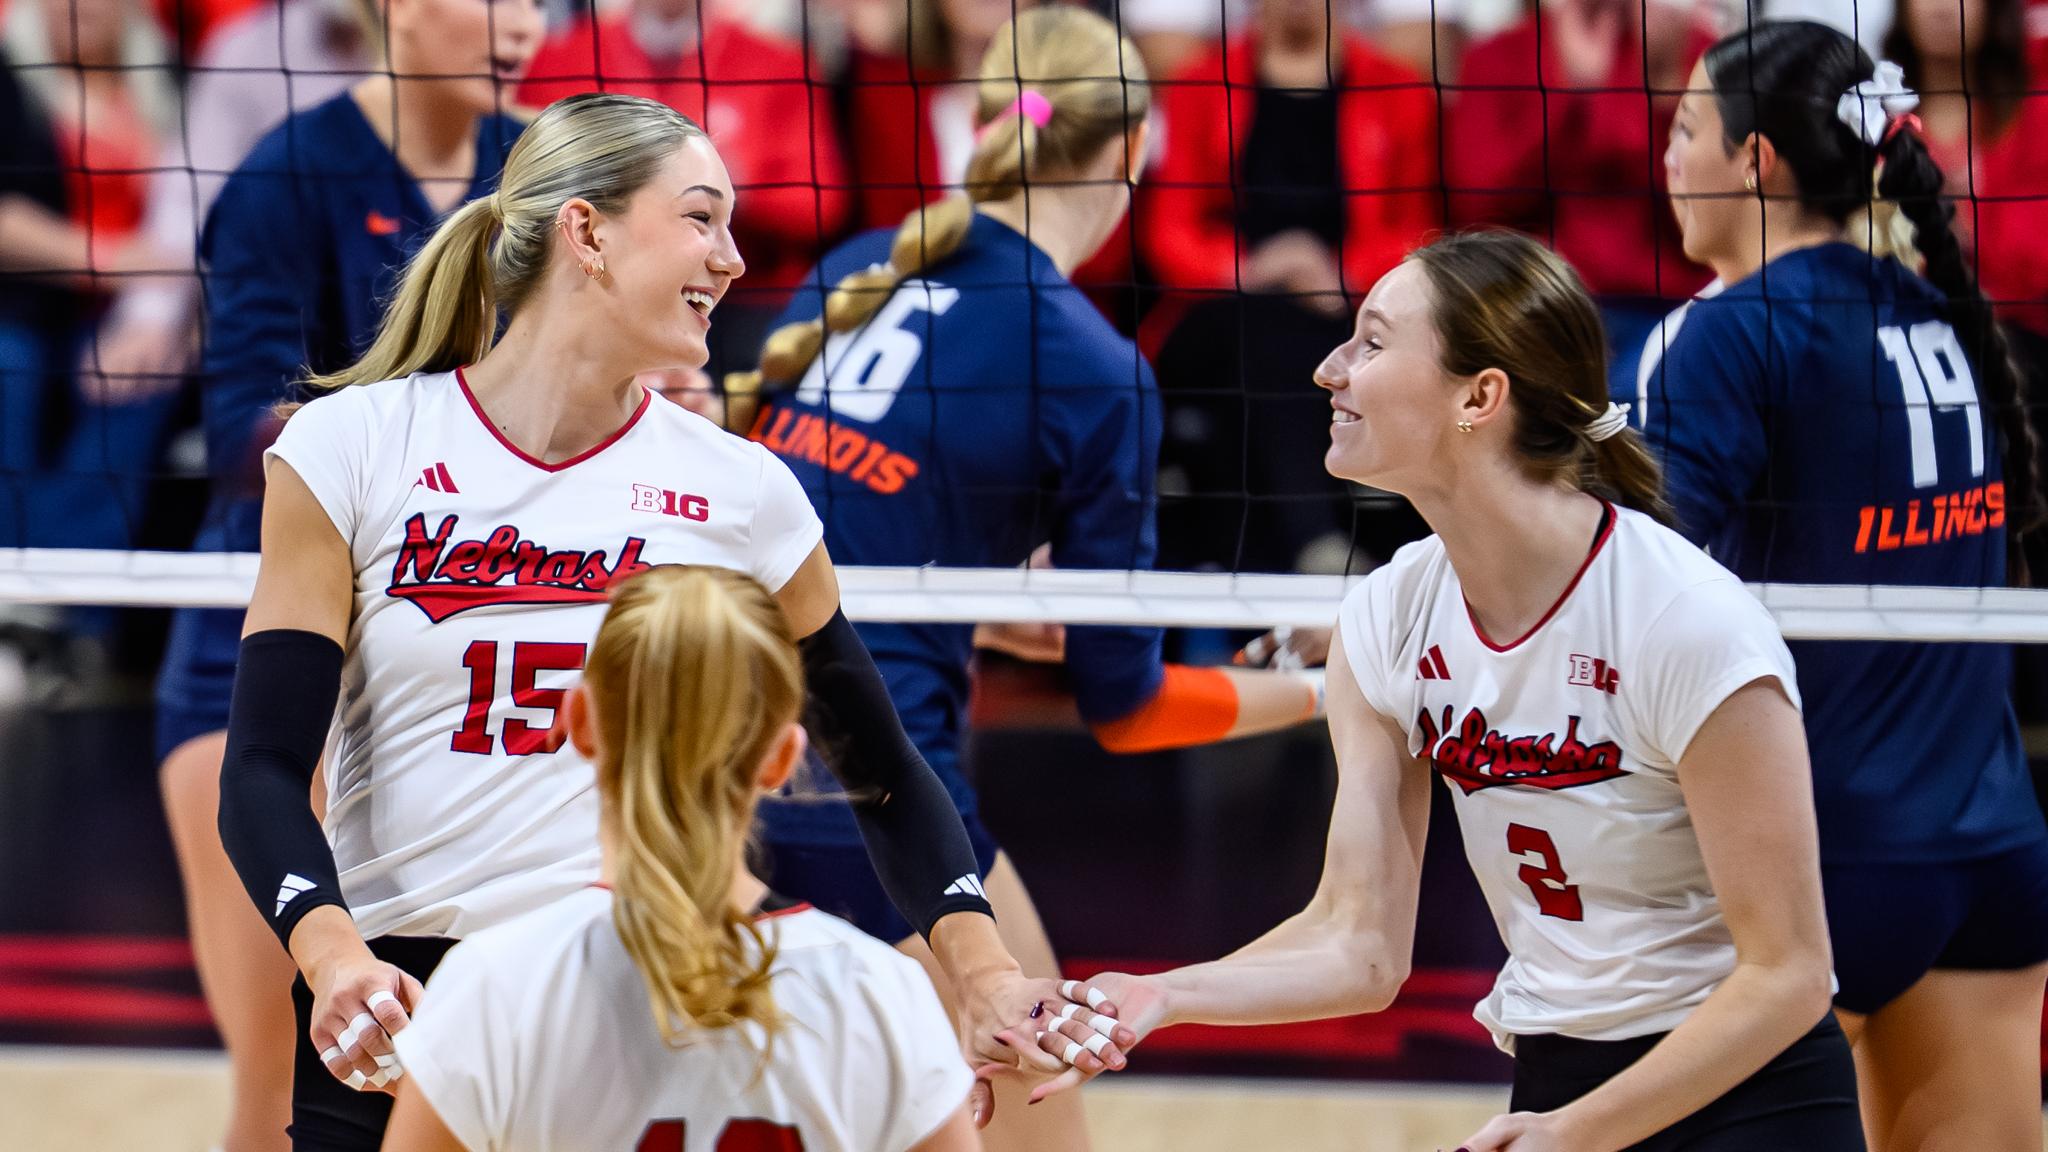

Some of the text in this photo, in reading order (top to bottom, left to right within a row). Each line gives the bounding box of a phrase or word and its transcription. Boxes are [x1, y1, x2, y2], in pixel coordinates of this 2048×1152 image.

[747, 403, 919, 494] LLINOIS
[1876, 319, 1984, 488] 19
[388, 511, 655, 598] Nebrask
[1854, 480, 2005, 554] ILLINOS
[450, 639, 588, 756] 15
[1506, 822, 1584, 922] 2
